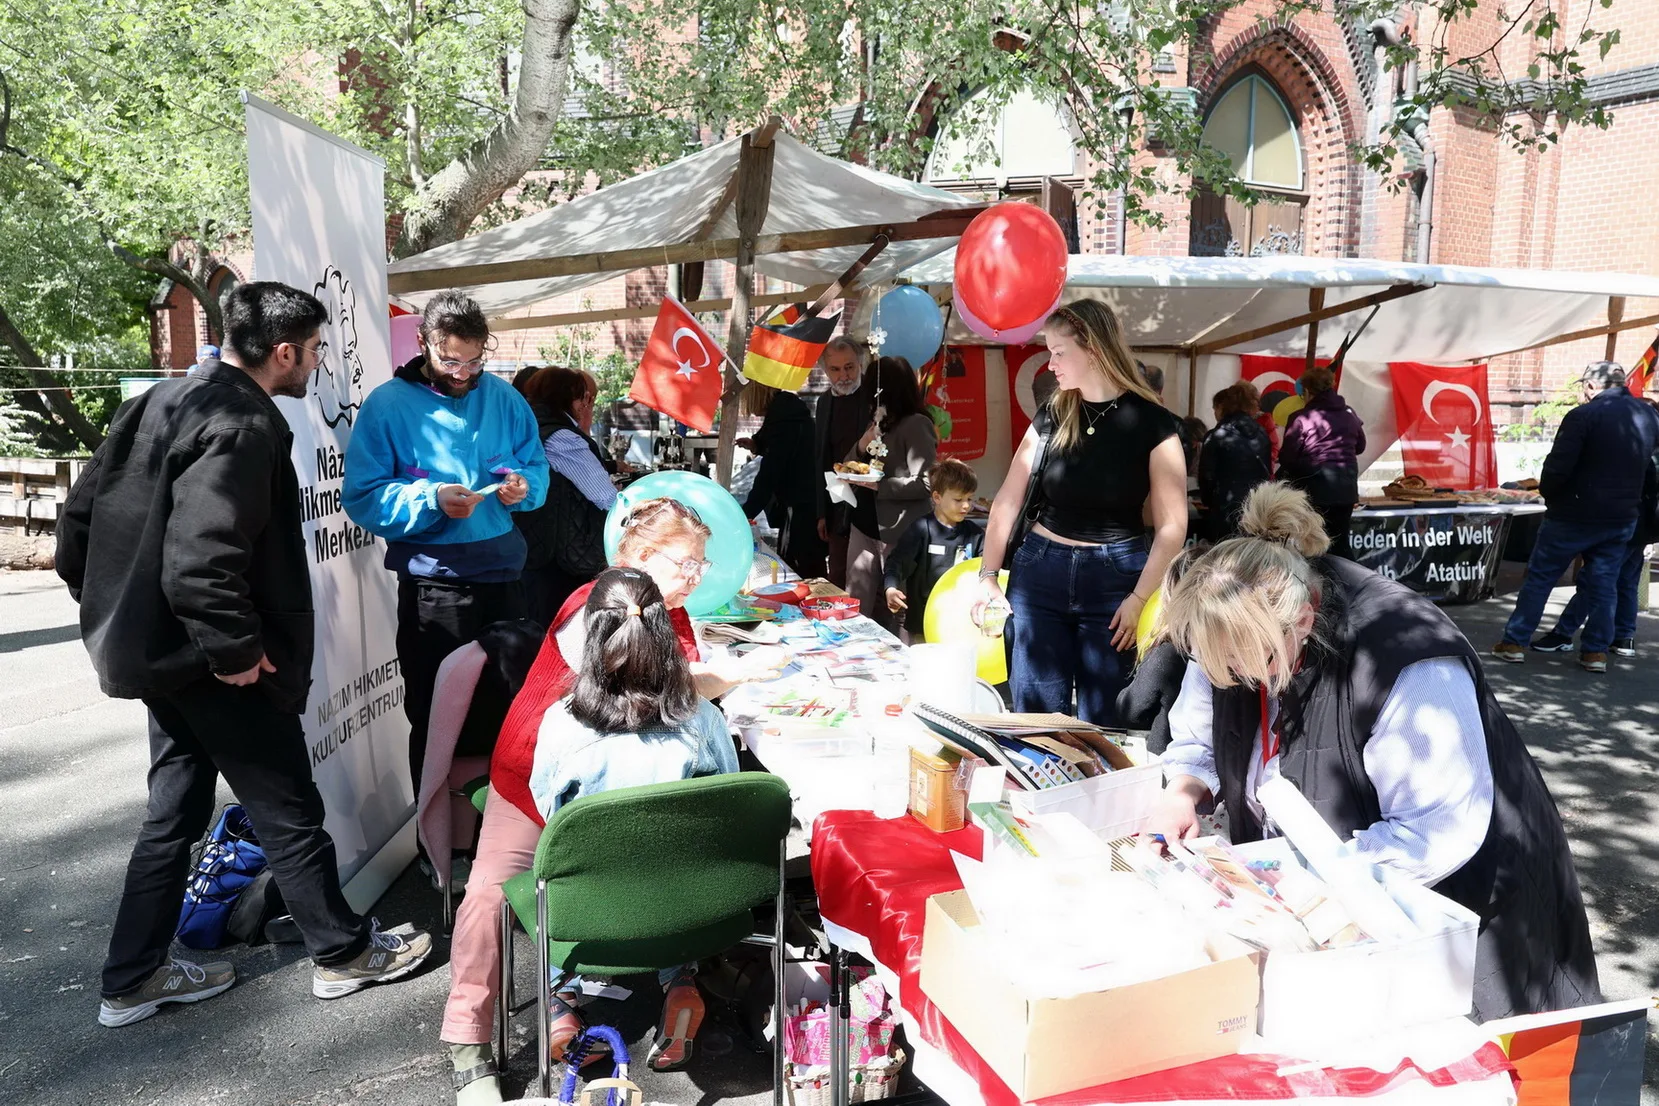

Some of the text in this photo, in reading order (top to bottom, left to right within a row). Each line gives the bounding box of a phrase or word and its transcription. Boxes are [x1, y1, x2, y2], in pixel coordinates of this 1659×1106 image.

[317, 445, 344, 482] Nâz
[299, 486, 342, 523] Hikme
[1349, 525, 1493, 549] ieden in der Welt
[1426, 561, 1486, 583] Atatürk
[317, 657, 402, 727] NAZIM HIKMET
[1218, 1015, 1248, 1029] TOMMY
